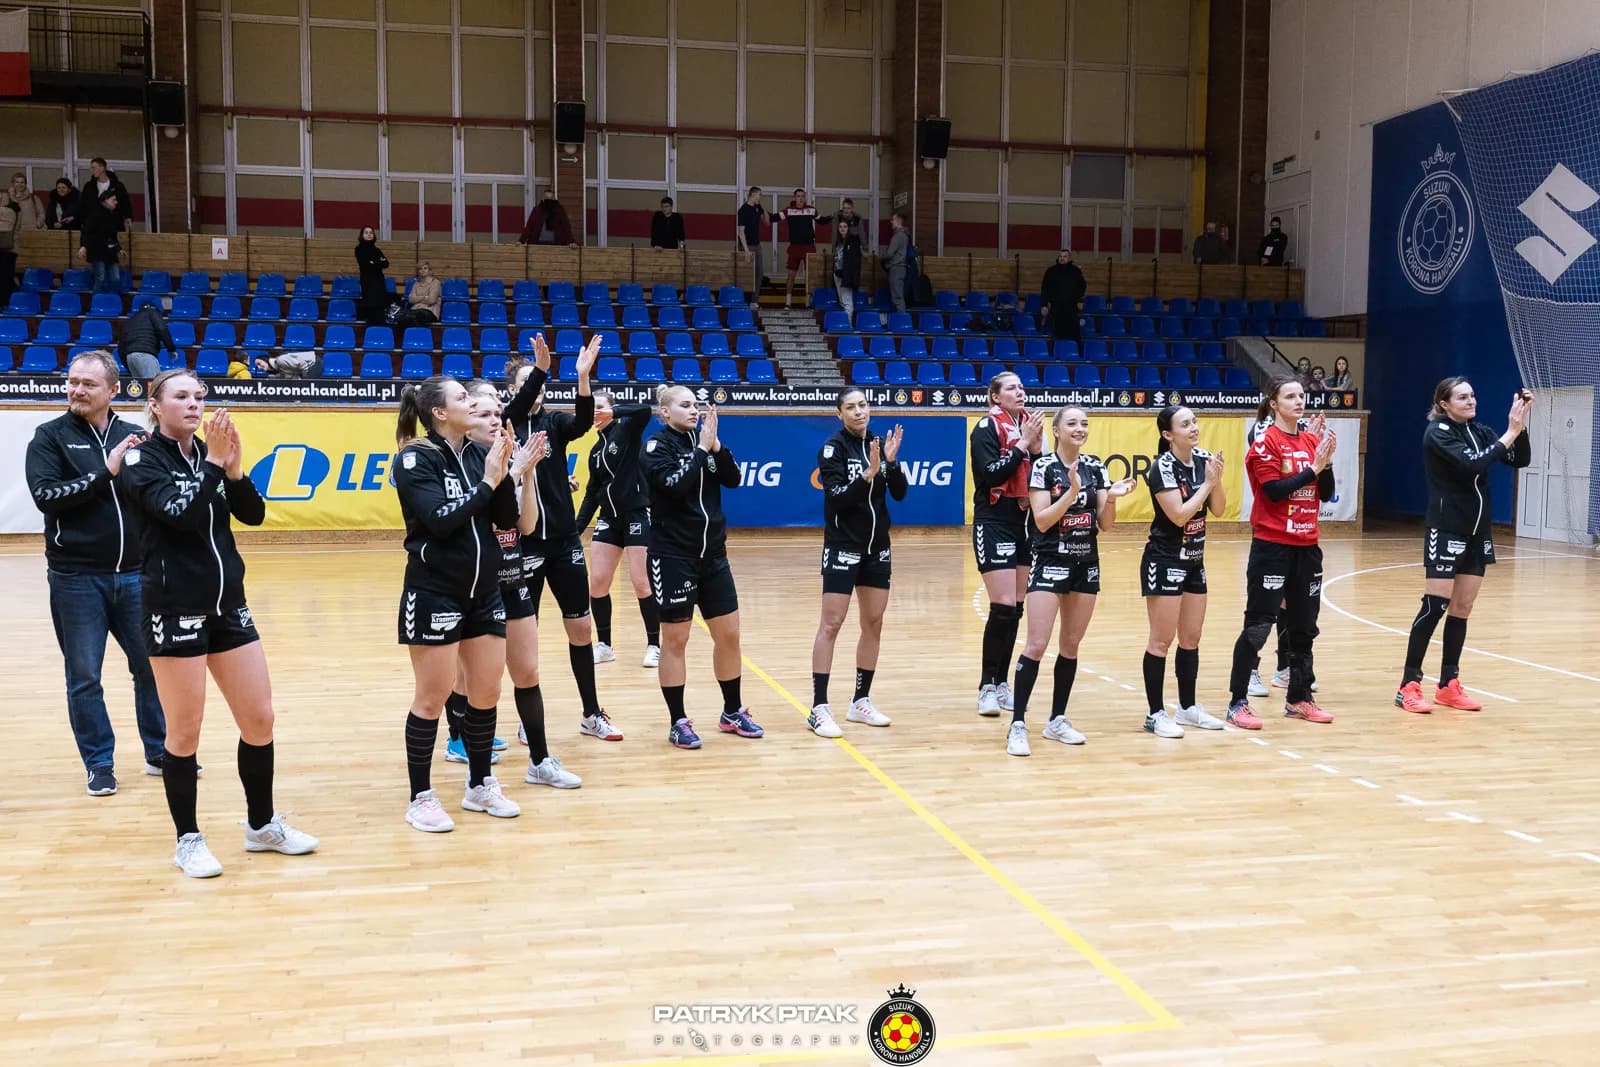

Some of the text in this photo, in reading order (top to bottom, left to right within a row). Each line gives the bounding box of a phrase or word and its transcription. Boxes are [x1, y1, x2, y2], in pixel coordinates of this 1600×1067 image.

[1423, 181, 1450, 199] SUZUKI
[1405, 237, 1464, 284] KORONA HANDBALL
[213, 382, 396, 400] www.koronahandball.pl
[336, 453, 397, 491] LE
